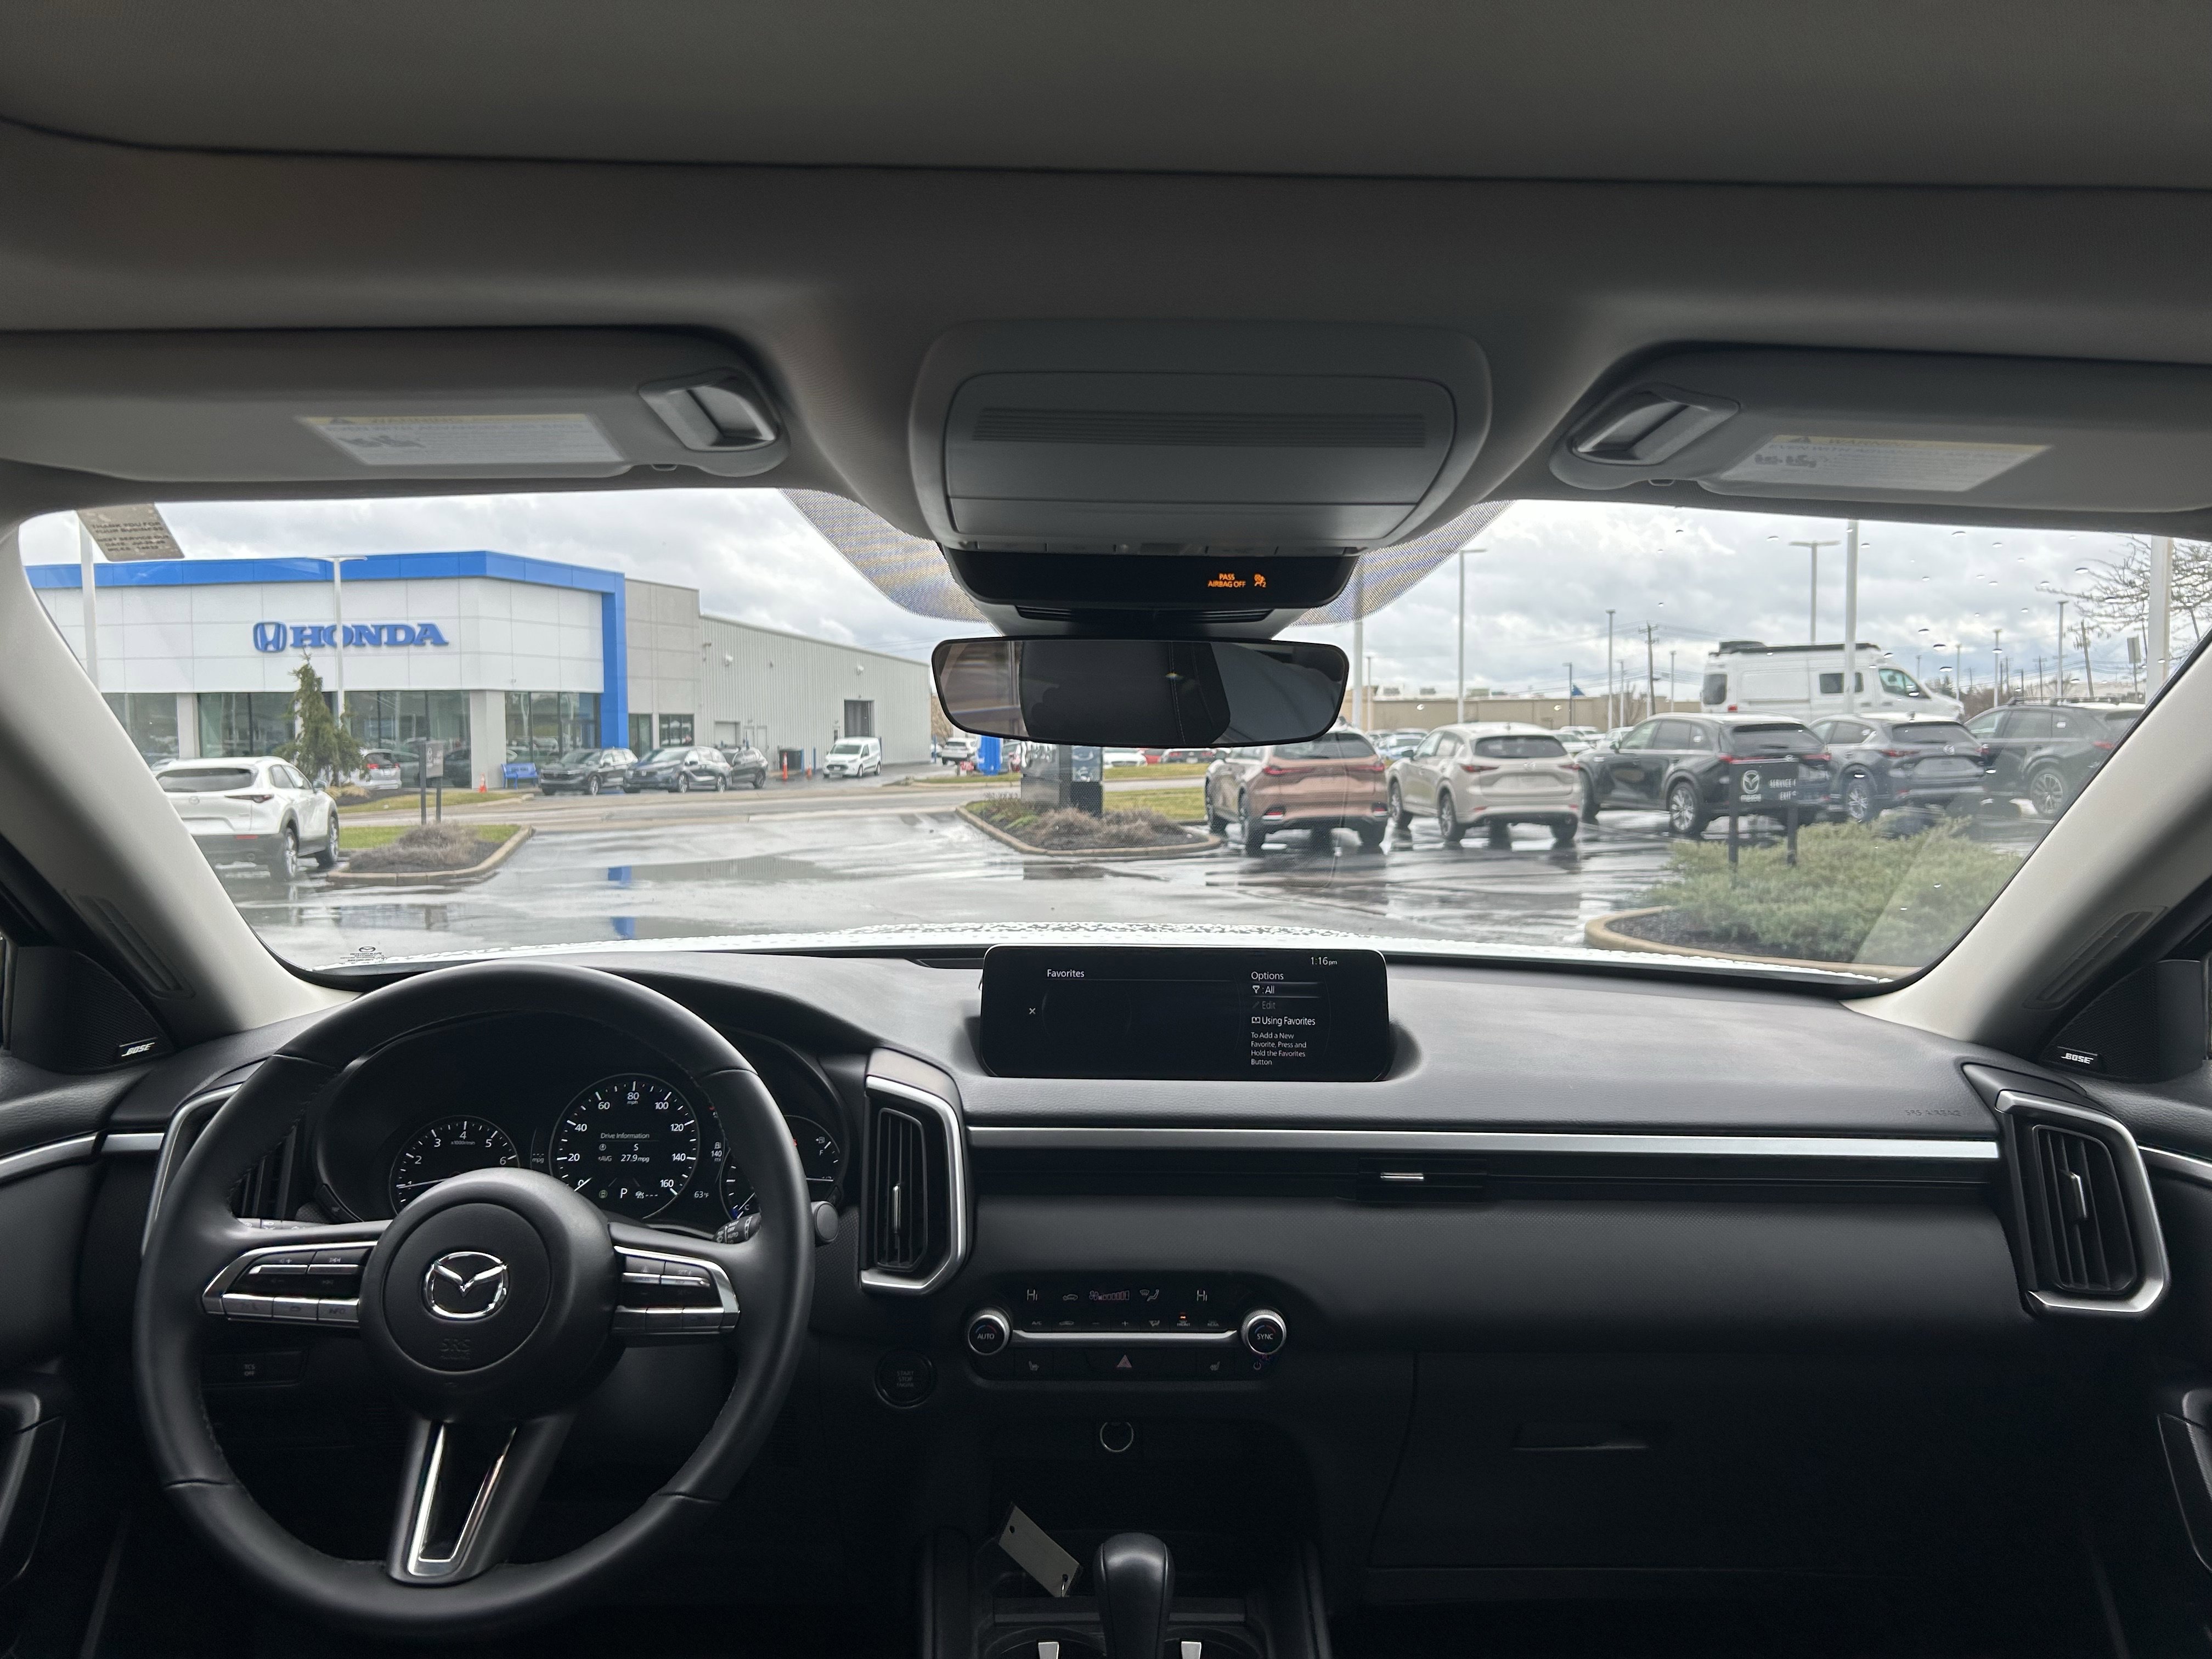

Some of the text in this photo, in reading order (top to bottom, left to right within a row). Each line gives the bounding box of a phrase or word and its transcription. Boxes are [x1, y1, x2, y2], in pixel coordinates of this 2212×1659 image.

[290, 622, 449, 646] HONDA
[1769, 779, 1792, 788] SERVICE
[1047, 969, 1085, 977] Favorites
[1251, 971, 1284, 981] Options
[1262, 1001, 1276, 1009] Edit
[1262, 1017, 1316, 1026] Using Favorites
[121, 1042, 155, 1057] BOSE
[2061, 1053, 2094, 1064] BOSE
[627, 1092, 640, 1101] 80
[597, 1102, 610, 1110] 60
[654, 1102, 669, 1110] 100
[575, 1124, 588, 1132] 40
[459, 1131, 467, 1139] 4
[434, 1138, 441, 1147] 3
[485, 1138, 492, 1147] 5
[415, 1155, 422, 1164] 2
[499, 1156, 507, 1165] 6
[567, 1153, 580, 1161] 20
[672, 1153, 686, 1161] 140
[660, 1180, 674, 1188] 160
[620, 1188, 628, 1199] P
